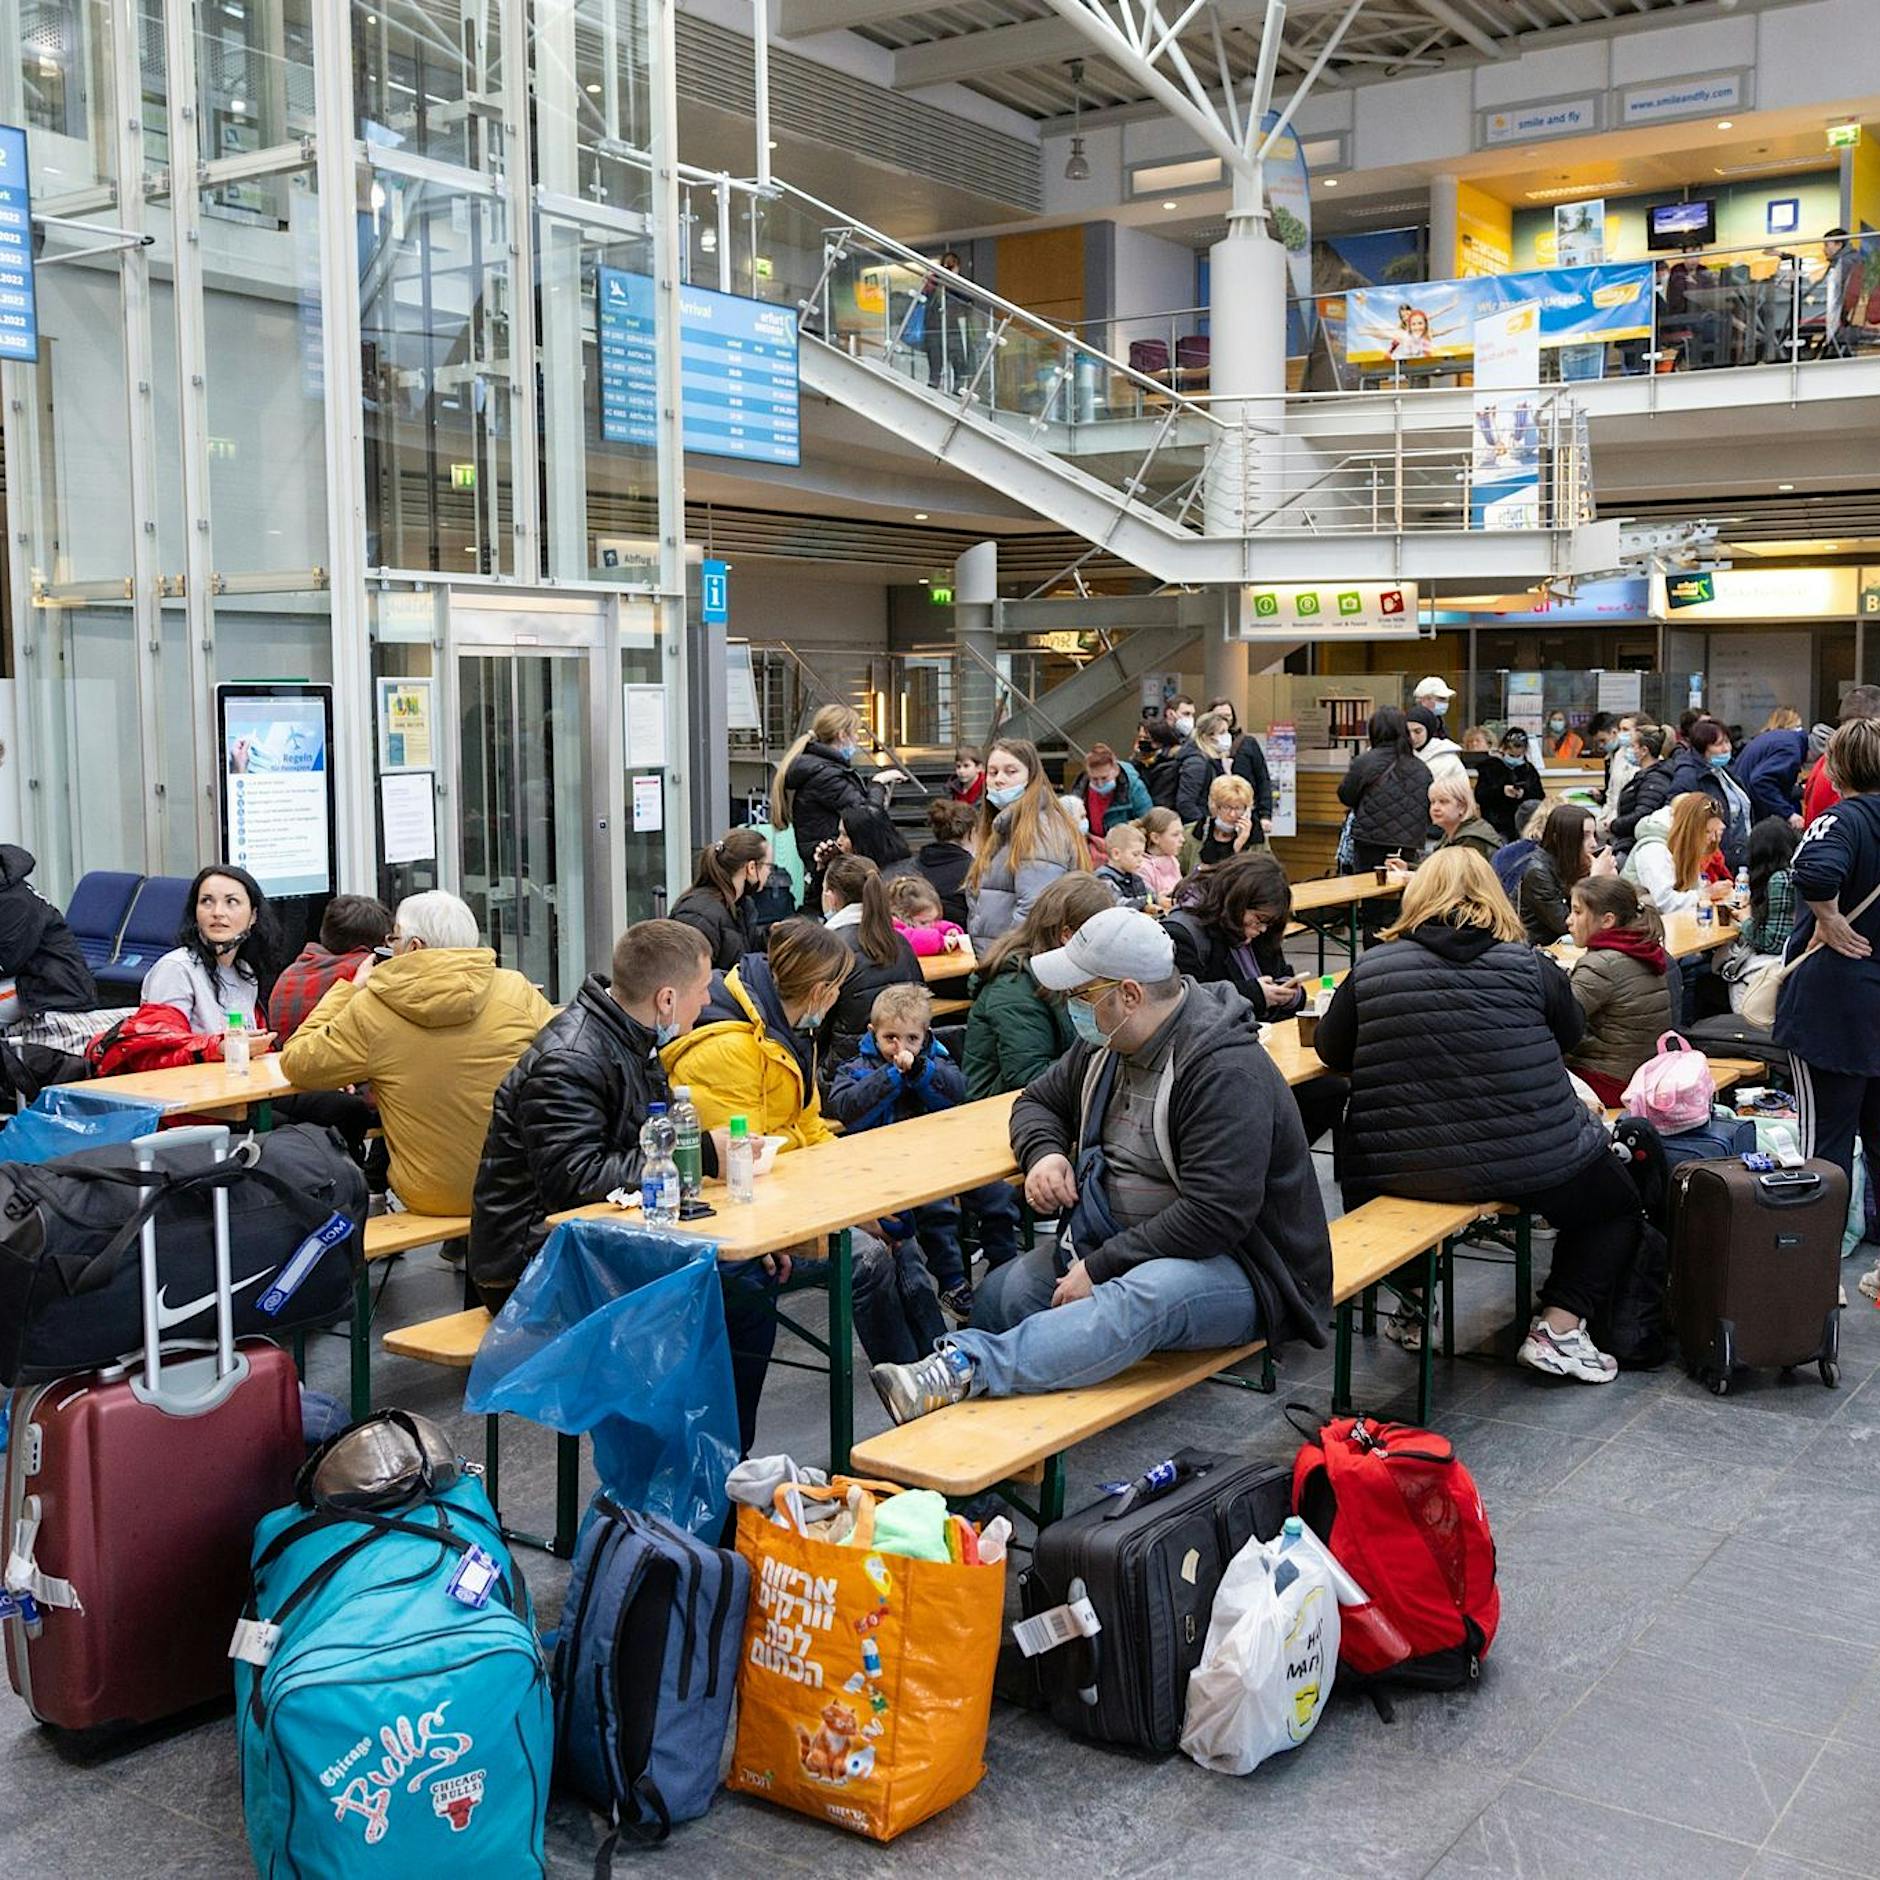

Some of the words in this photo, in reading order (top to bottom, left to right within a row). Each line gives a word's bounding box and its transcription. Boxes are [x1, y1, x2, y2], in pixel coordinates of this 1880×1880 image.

[1630, 86, 1733, 111] www.smileandfly.com
[1518, 117, 1544, 130] smile
[1547, 114, 1566, 126] and
[1568, 111, 1581, 125] fly
[321, 1220, 347, 1243] IOM
[319, 1736, 373, 1788] Chicago
[330, 1699, 473, 1845] Bulls
[432, 1770, 486, 1793] CHICAGO
[438, 1783, 482, 1803] BULLS
